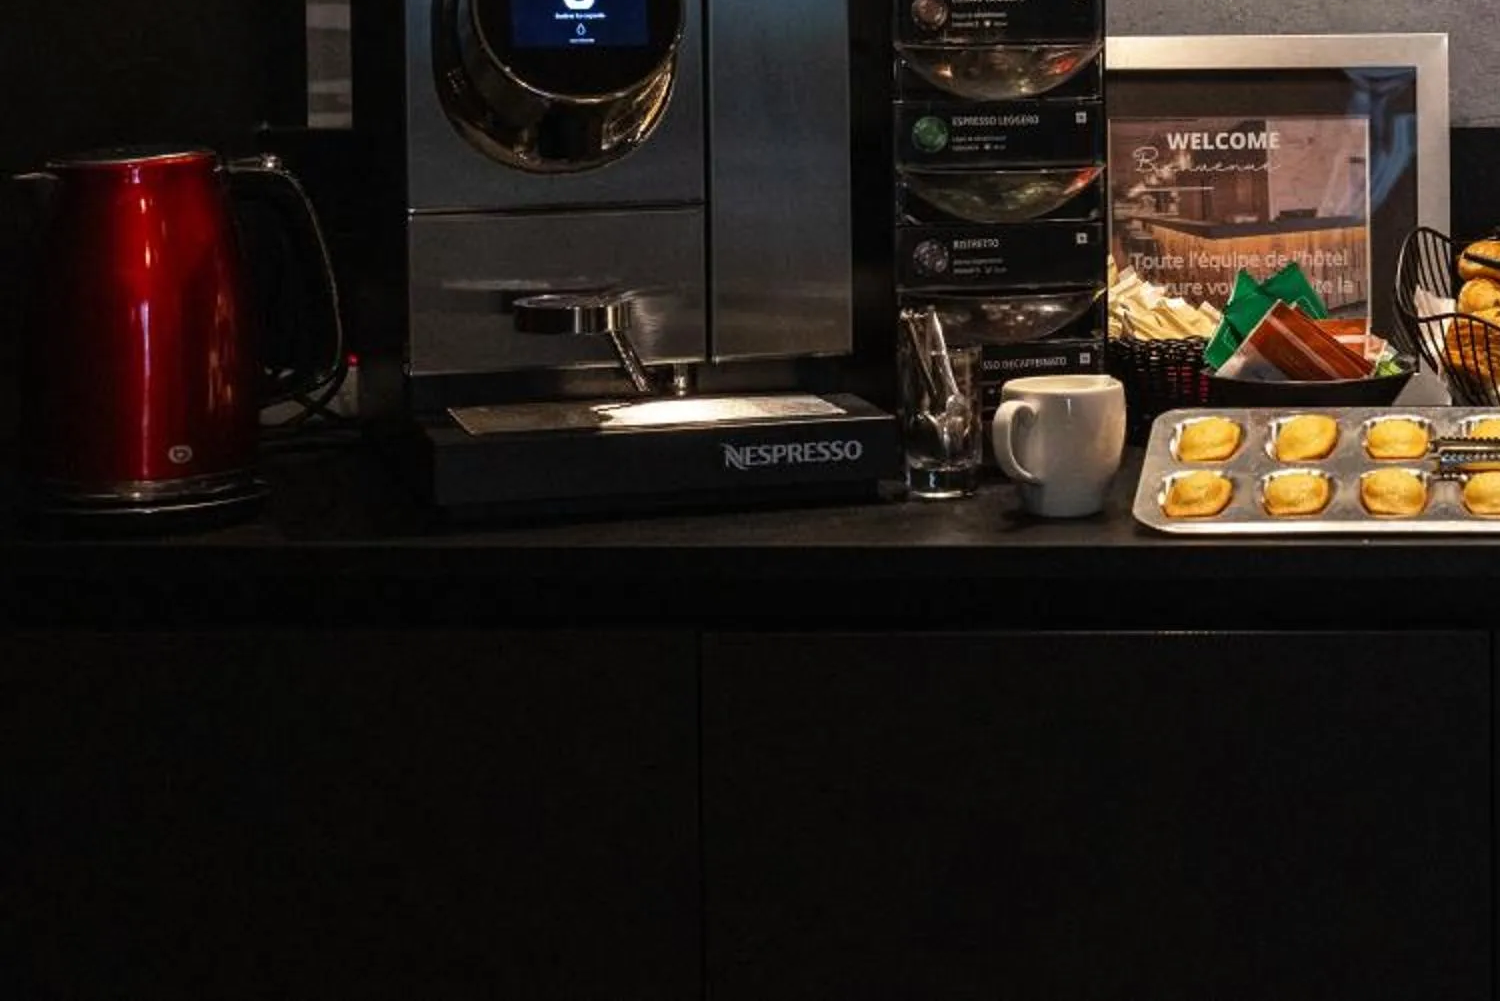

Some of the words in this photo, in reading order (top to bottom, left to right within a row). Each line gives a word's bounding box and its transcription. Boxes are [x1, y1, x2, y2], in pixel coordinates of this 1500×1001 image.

[1167, 131, 1281, 150] WELCOME
[1132, 253, 1184, 269] Toute
[1188, 251, 1261, 272] l'équipe
[1265, 252, 1287, 267] de
[1293, 250, 1348, 267] l'hôtel
[1338, 276, 1353, 294] la
[720, 440, 863, 470] NESPRESSO
